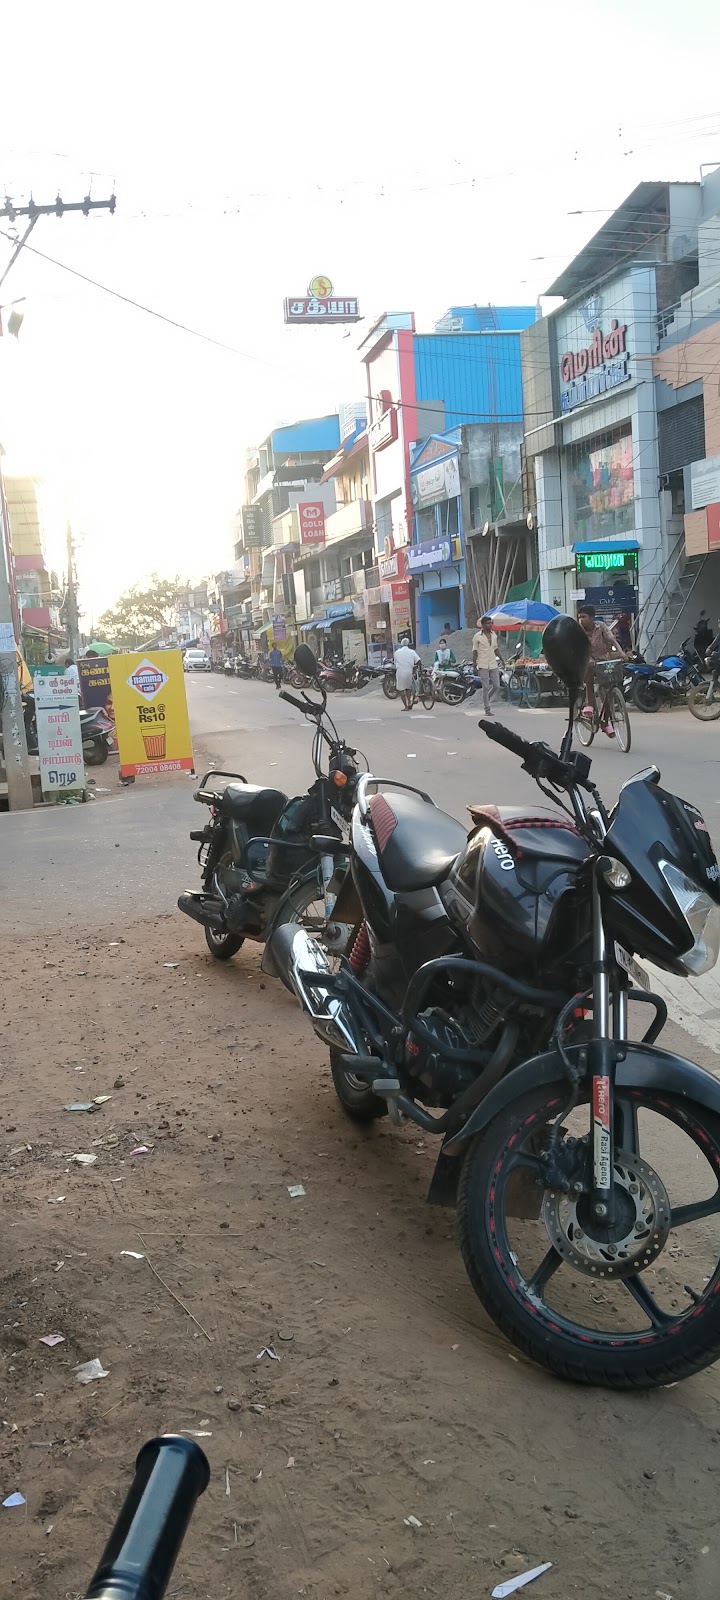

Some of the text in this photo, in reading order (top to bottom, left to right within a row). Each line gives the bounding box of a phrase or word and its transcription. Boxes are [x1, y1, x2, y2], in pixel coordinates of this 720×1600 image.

[302, 520, 324, 528] GOLD
[303, 530, 325, 538] LOAN
[59, 677, 75, 687] தேவி
[133, 674, 162, 684] namma
[52, 686, 73, 695] மெஸ்
[136, 703, 166, 715] Tea @
[47, 711, 70, 724] காபி
[138, 712, 166, 724] Rs10
[56, 725, 63, 736] &
[48, 735, 73, 751] டிபன்
[42, 752, 82, 766] சாப்பாடு
[135, 765, 159, 775] 72004
[47, 770, 77, 787] ரெடி
[490, 838, 515, 870] Hero
[597, 1091, 606, 1114] Hero
[598, 1155, 609, 1188] Agency
